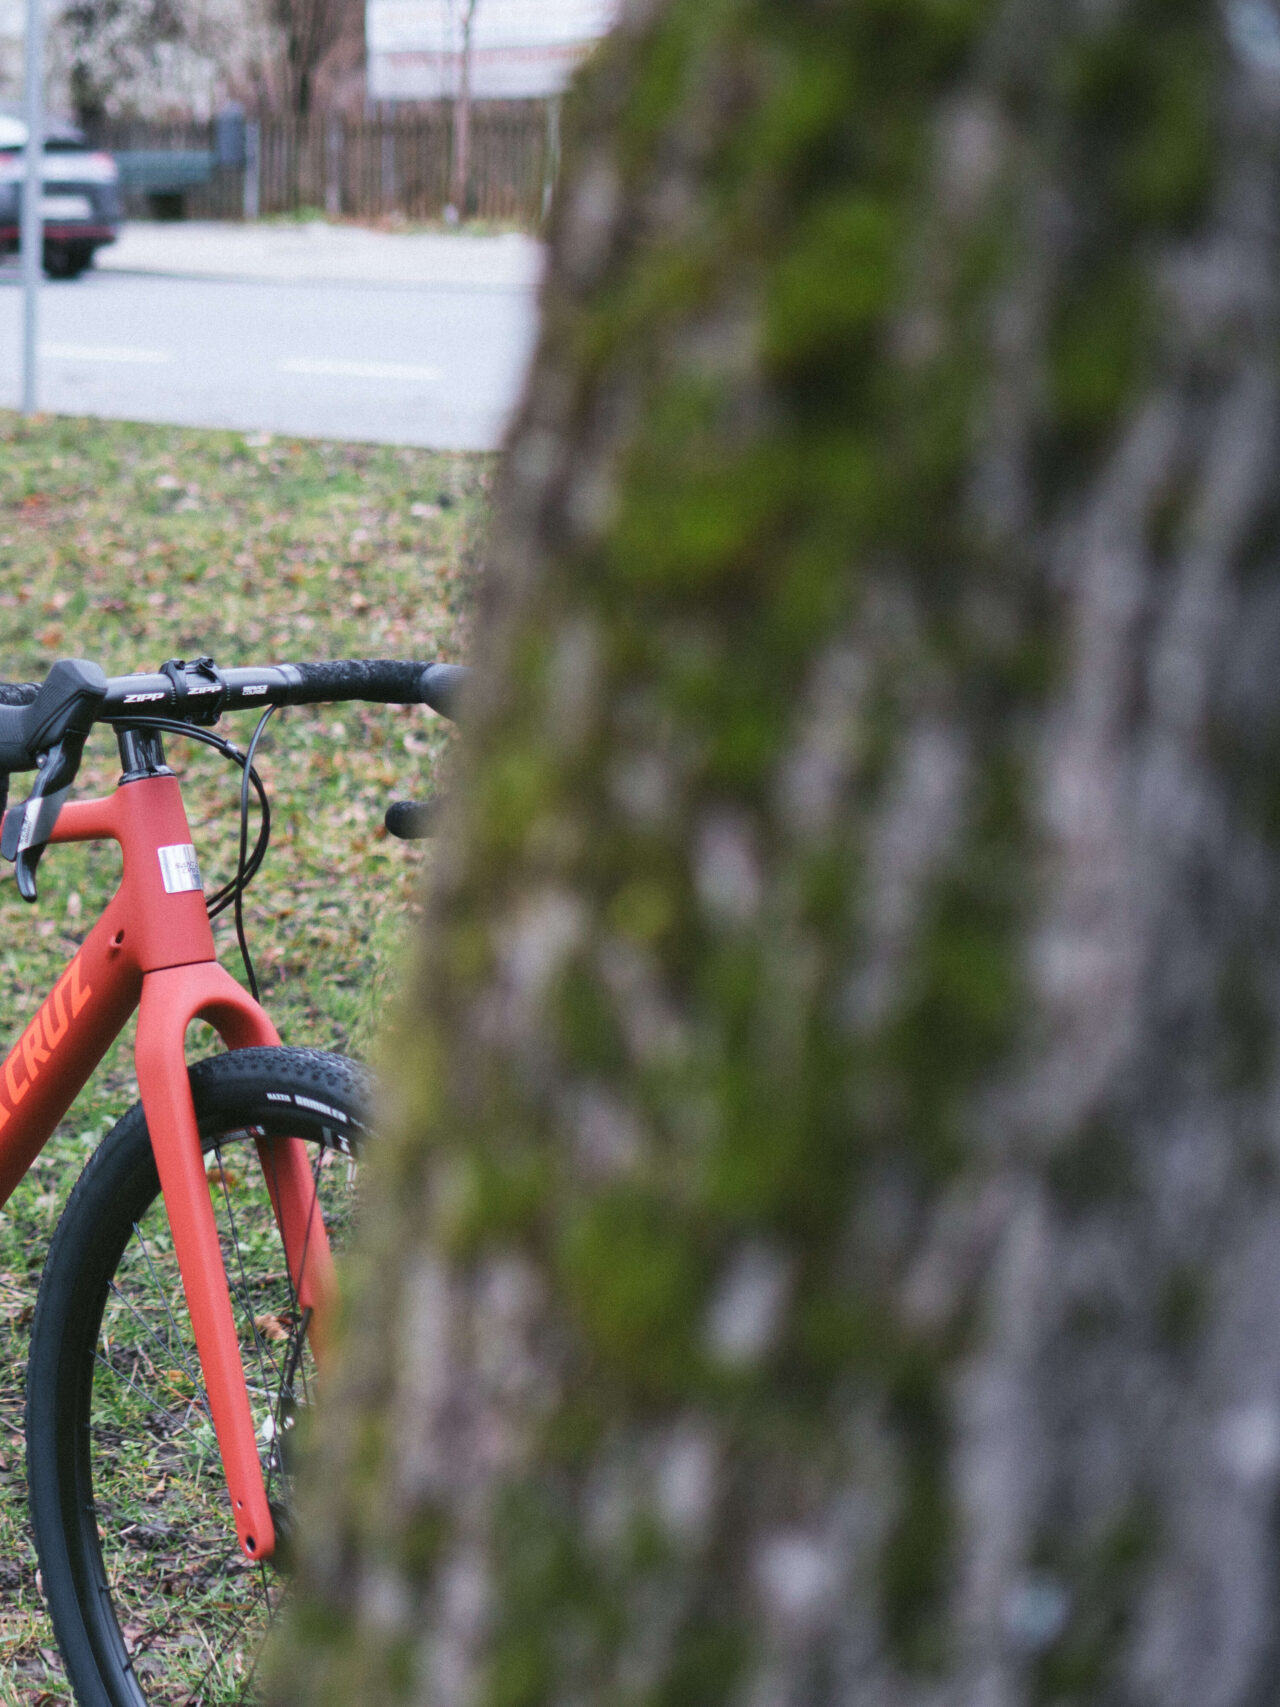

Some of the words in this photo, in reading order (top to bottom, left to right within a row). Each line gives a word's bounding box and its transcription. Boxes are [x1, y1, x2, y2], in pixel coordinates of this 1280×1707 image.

[187, 685, 223, 695] ZIPP
[123, 692, 166, 704] ZIPP
[4, 956, 92, 1106] CRUZ
